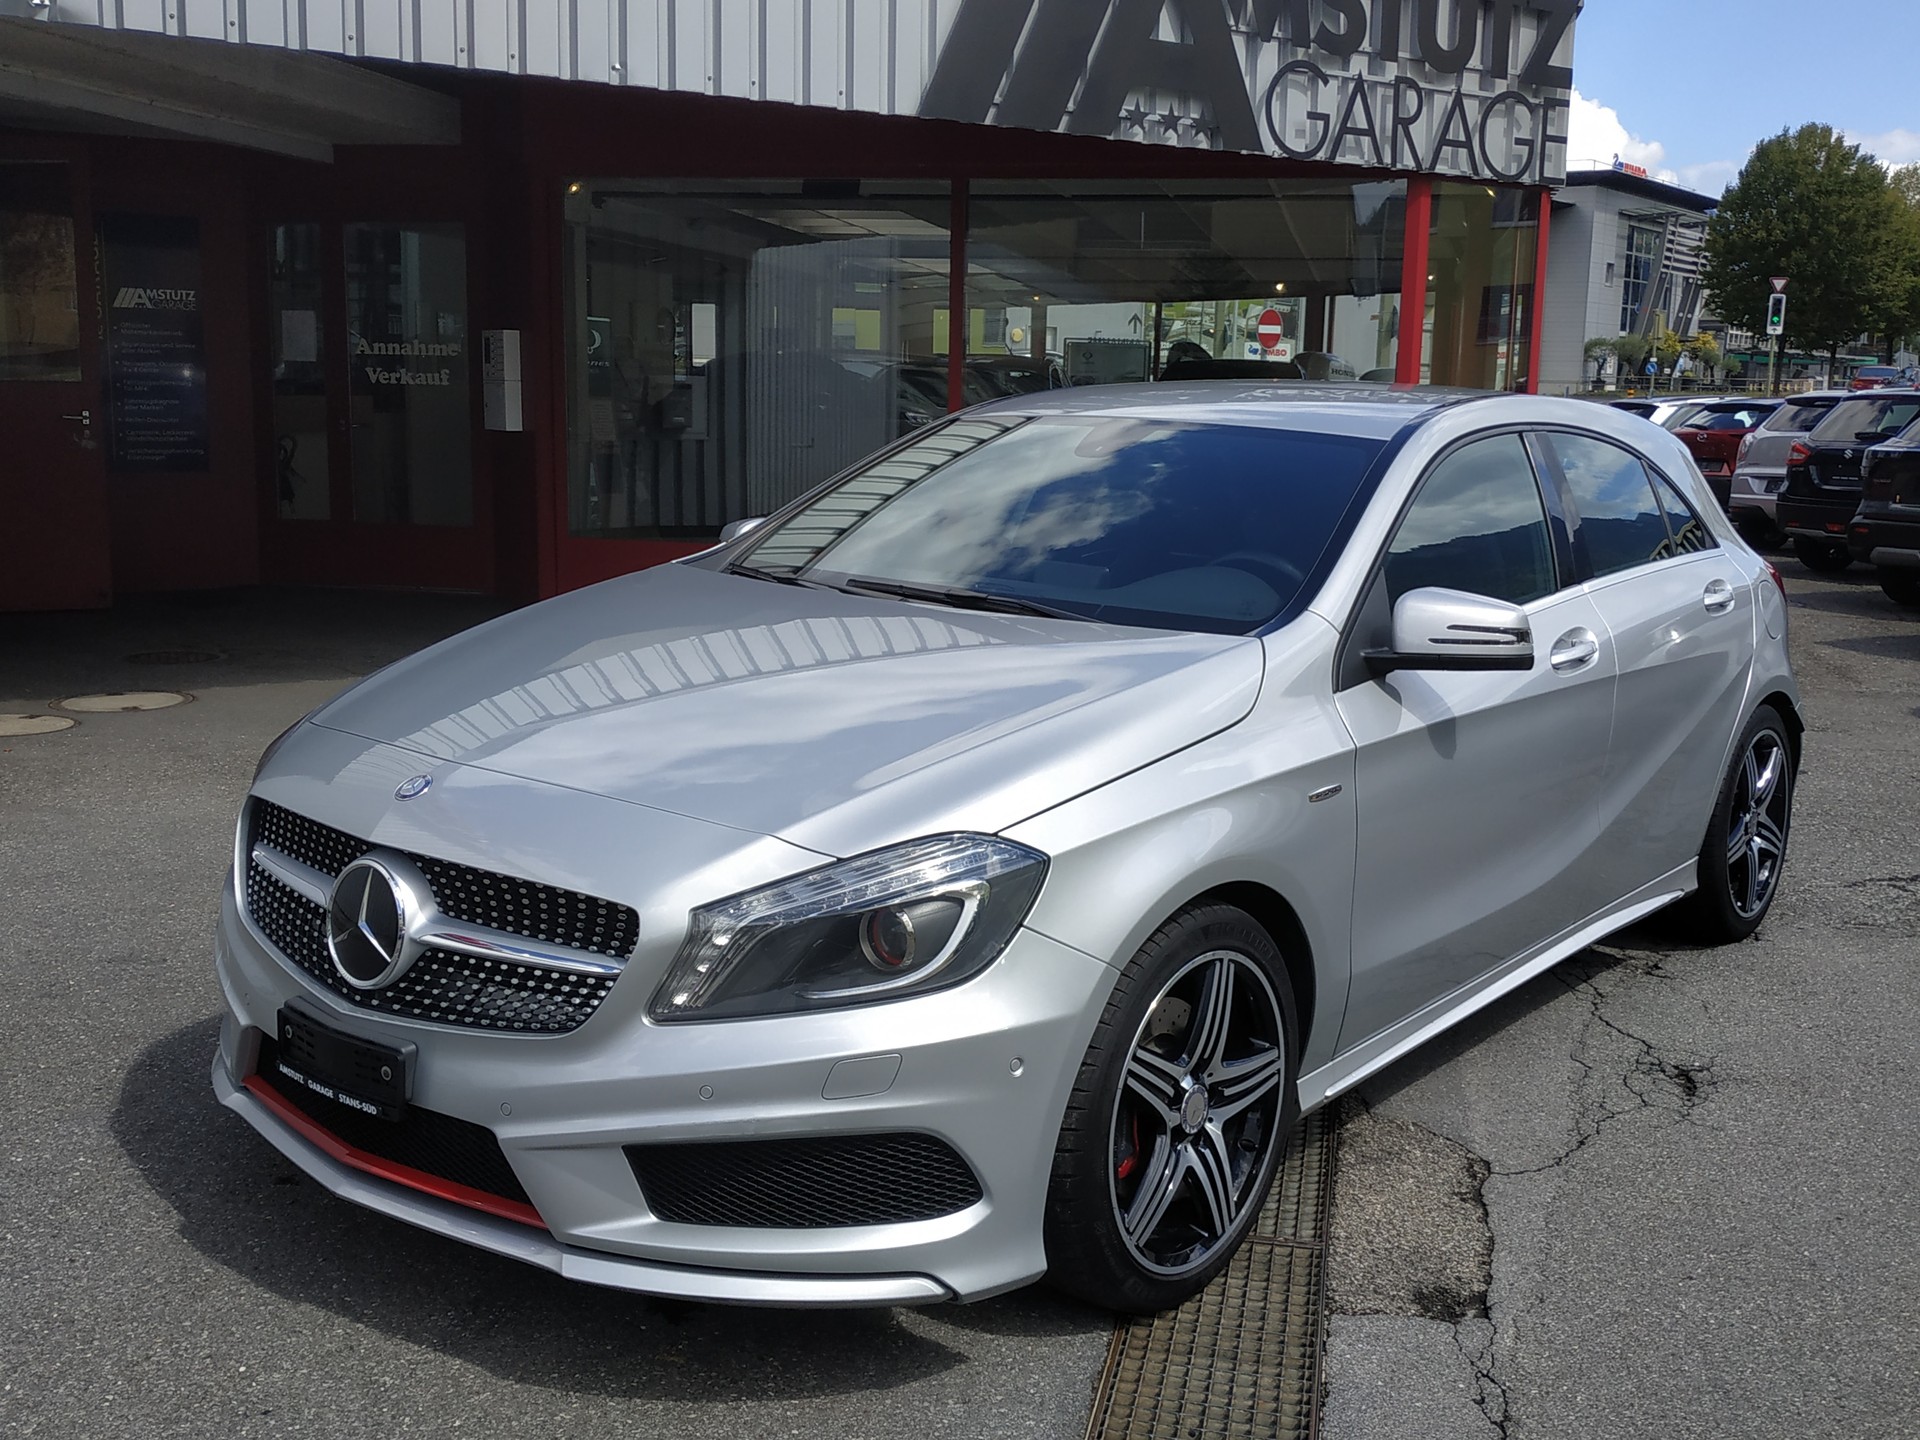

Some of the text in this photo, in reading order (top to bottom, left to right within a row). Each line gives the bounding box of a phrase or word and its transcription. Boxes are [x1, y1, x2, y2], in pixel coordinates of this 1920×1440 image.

[1265, 59, 1570, 185] GARAGE
[126, 287, 196, 309] AMSTUTZ
[151, 299, 197, 311] GARAGE
[355, 337, 459, 357] Annahme
[364, 366, 451, 386] Verkauf
[1331, 368, 1355, 377] HOND
[279, 1063, 378, 1115] AMSTUTZ GARAGE STANS-SÜD
